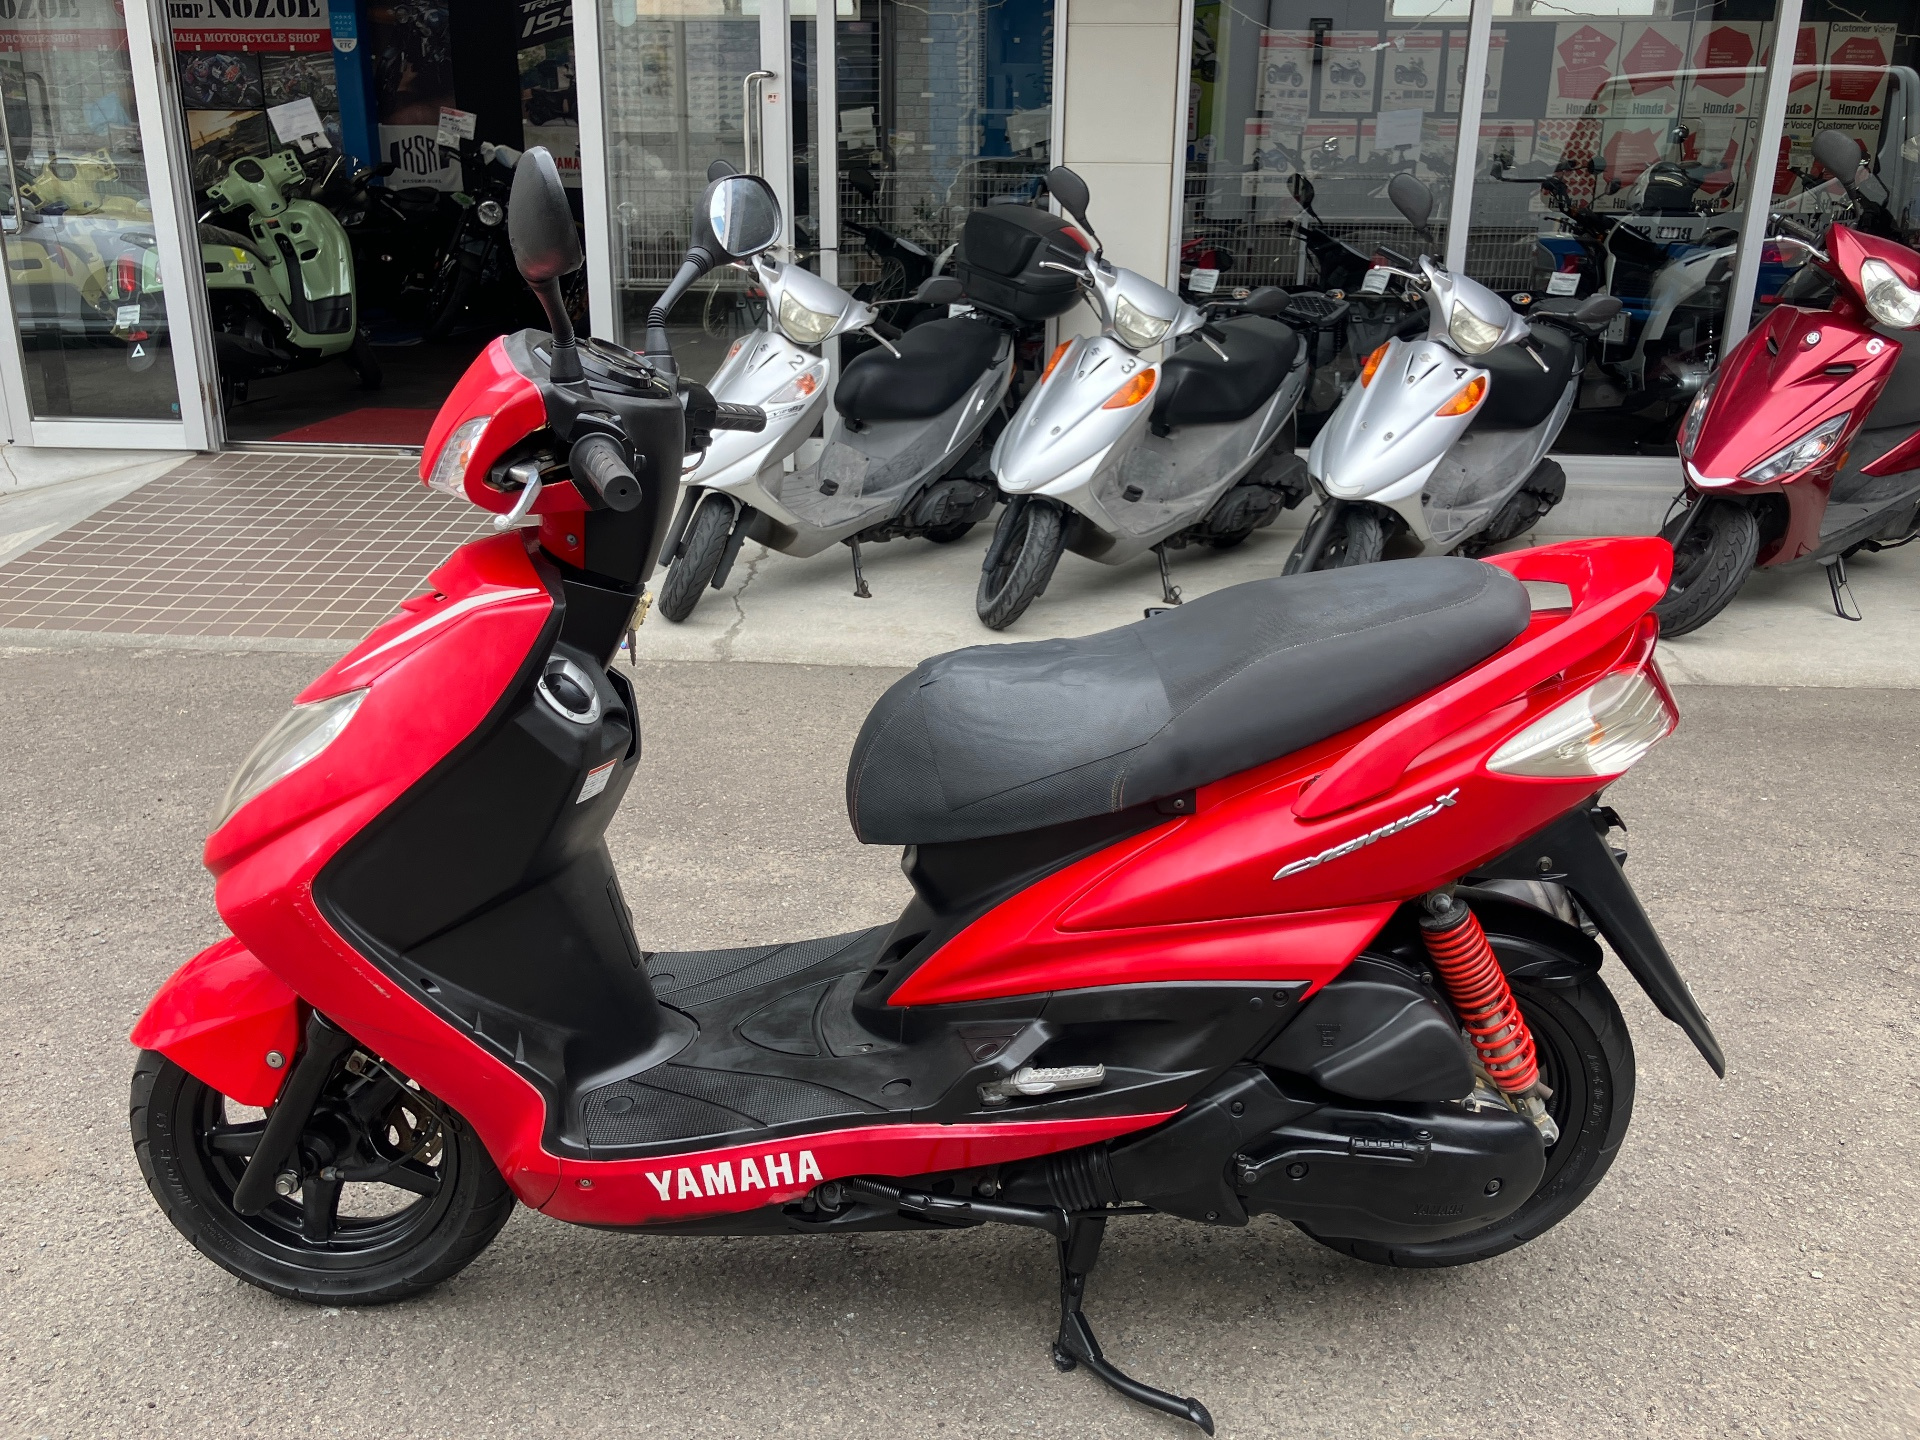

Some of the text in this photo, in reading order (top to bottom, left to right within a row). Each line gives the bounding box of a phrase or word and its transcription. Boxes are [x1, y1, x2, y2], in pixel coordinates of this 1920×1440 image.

[1832, 23, 1872, 33] Customer
[204, 33, 286, 42] MOTORCYCLE
[288, 33, 320, 43] SHOP
[1565, 102, 1598, 115] Honda
[1632, 102, 1664, 115] Honda
[1702, 102, 1735, 114] Honda
[1837, 103, 1870, 115] Honda
[1791, 120, 1813, 129] Voice
[1817, 120, 1880, 131] Customer Voice
[1865, 338, 1885, 355] 6
[788, 354, 804, 371] 2
[1121, 358, 1136, 374] 3
[1453, 367, 1468, 380] 4
[645, 1150, 824, 1202] YAMAHA
